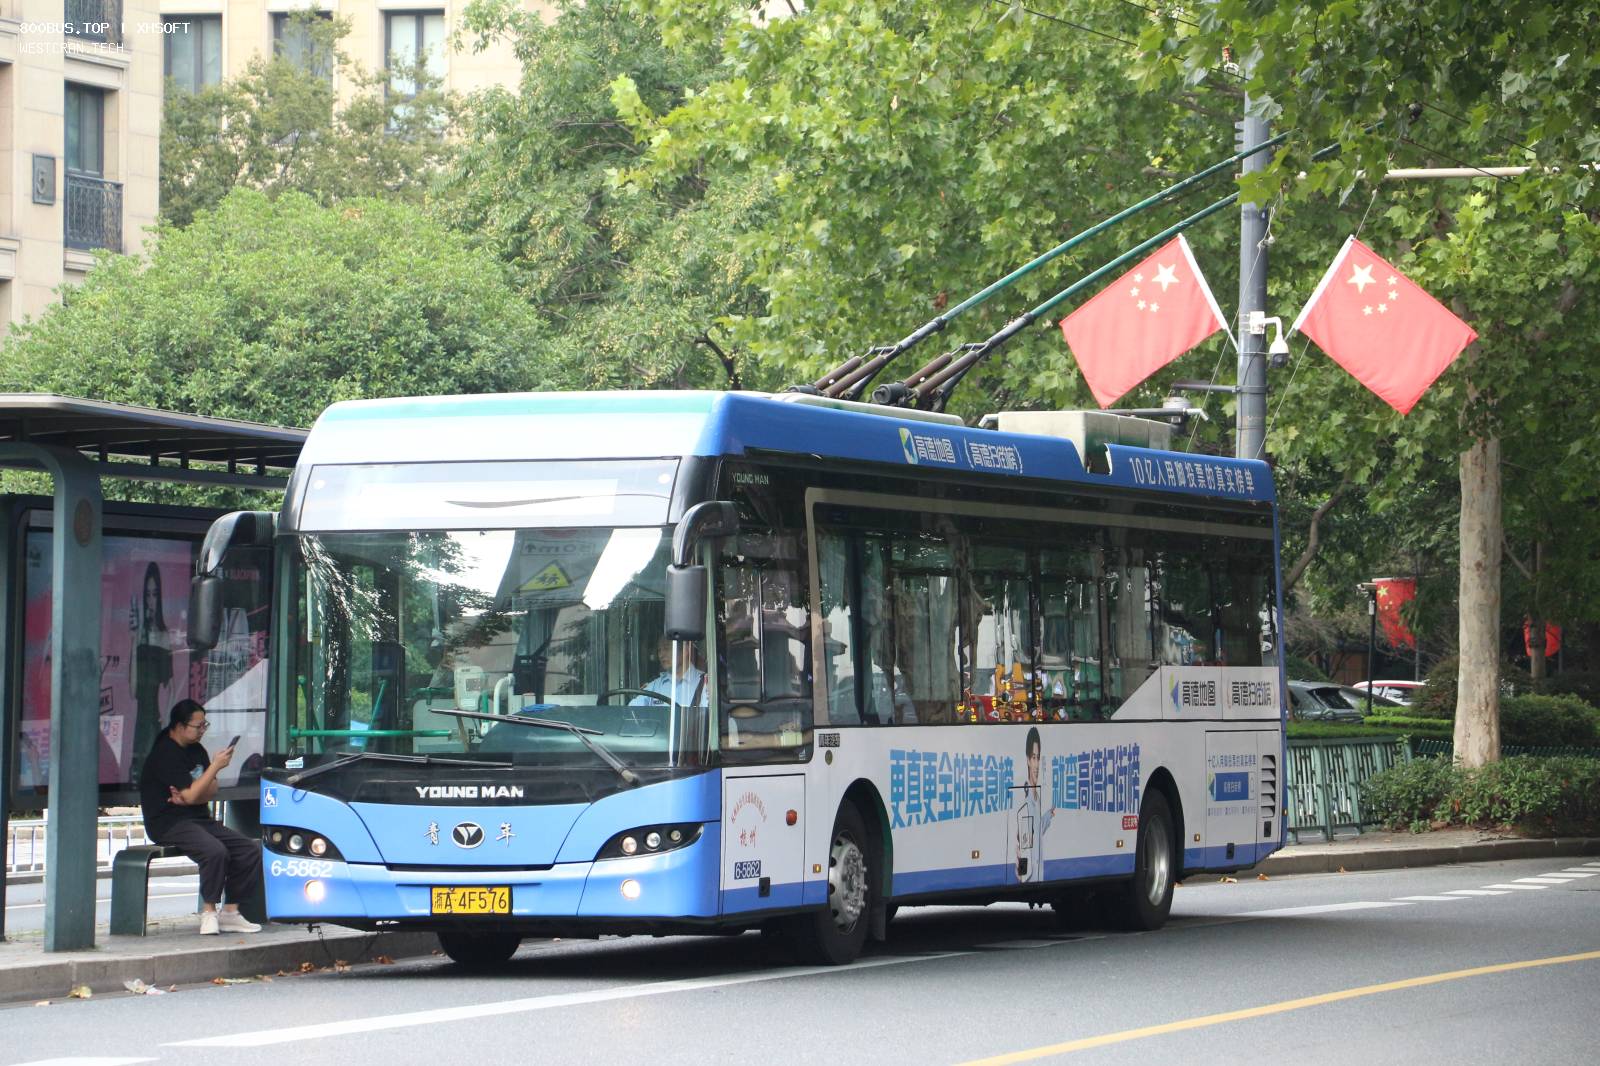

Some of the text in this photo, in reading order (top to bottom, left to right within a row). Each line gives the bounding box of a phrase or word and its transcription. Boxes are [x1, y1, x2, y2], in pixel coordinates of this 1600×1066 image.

[732, 472, 769, 485] YOUNG MAN
[1129, 457, 1255, 494] 10亿人用脚投票的真实榜单
[1182, 680, 1216, 706] 高德地图
[416, 786, 525, 798] YOUNG MAN
[890, 749, 1014, 829] 更真更全的美食榜
[1051, 742, 1141, 814] 就查高德扫街榜
[271, 860, 333, 878] 6-5862
[735, 861, 760, 879] 6-5862
